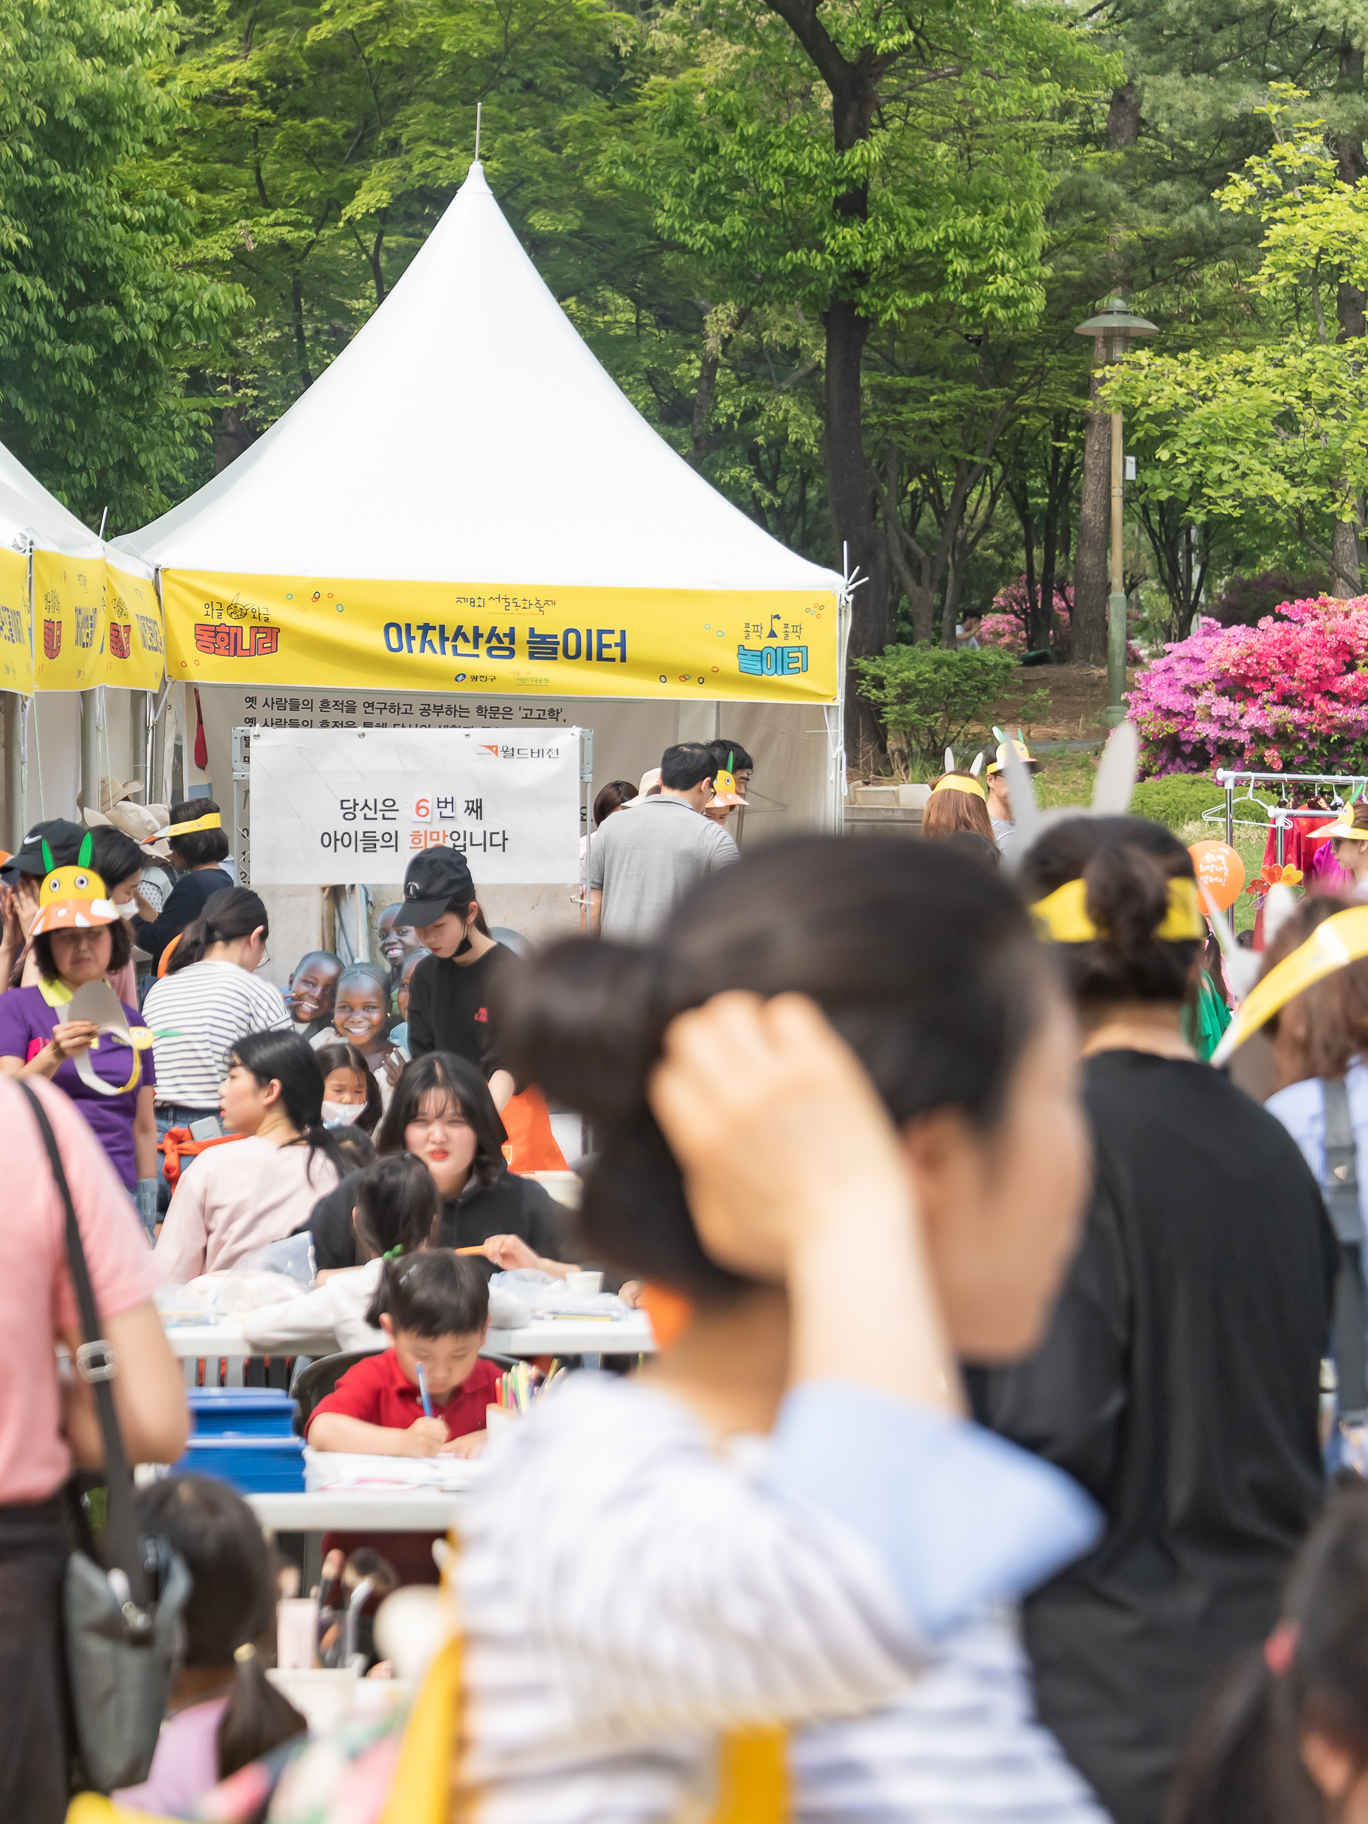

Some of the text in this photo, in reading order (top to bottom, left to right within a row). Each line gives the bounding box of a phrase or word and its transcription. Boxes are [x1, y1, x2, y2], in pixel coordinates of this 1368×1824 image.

[203, 600, 271, 623] 와글 와글
[454, 595, 486, 608] 제8회
[194, 622, 281, 657] 동화나라
[382, 621, 627, 663] 아차산성 놀이터
[743, 622, 803, 640] 폴짝 폴짝
[469, 674, 497, 683] 광진구
[244, 695, 257, 711] 옛
[261, 696, 315, 713] 사람들의
[318, 698, 358, 714] 흔적을
[362, 700, 415, 717] 연구하고
[418, 702, 471, 719] 공부하는
[475, 704, 514, 721] 학문은
[499, 744, 560, 759] 월드비전
[339, 797, 400, 821] 당신은
[320, 829, 509, 853] 아이들의 희망입니다
